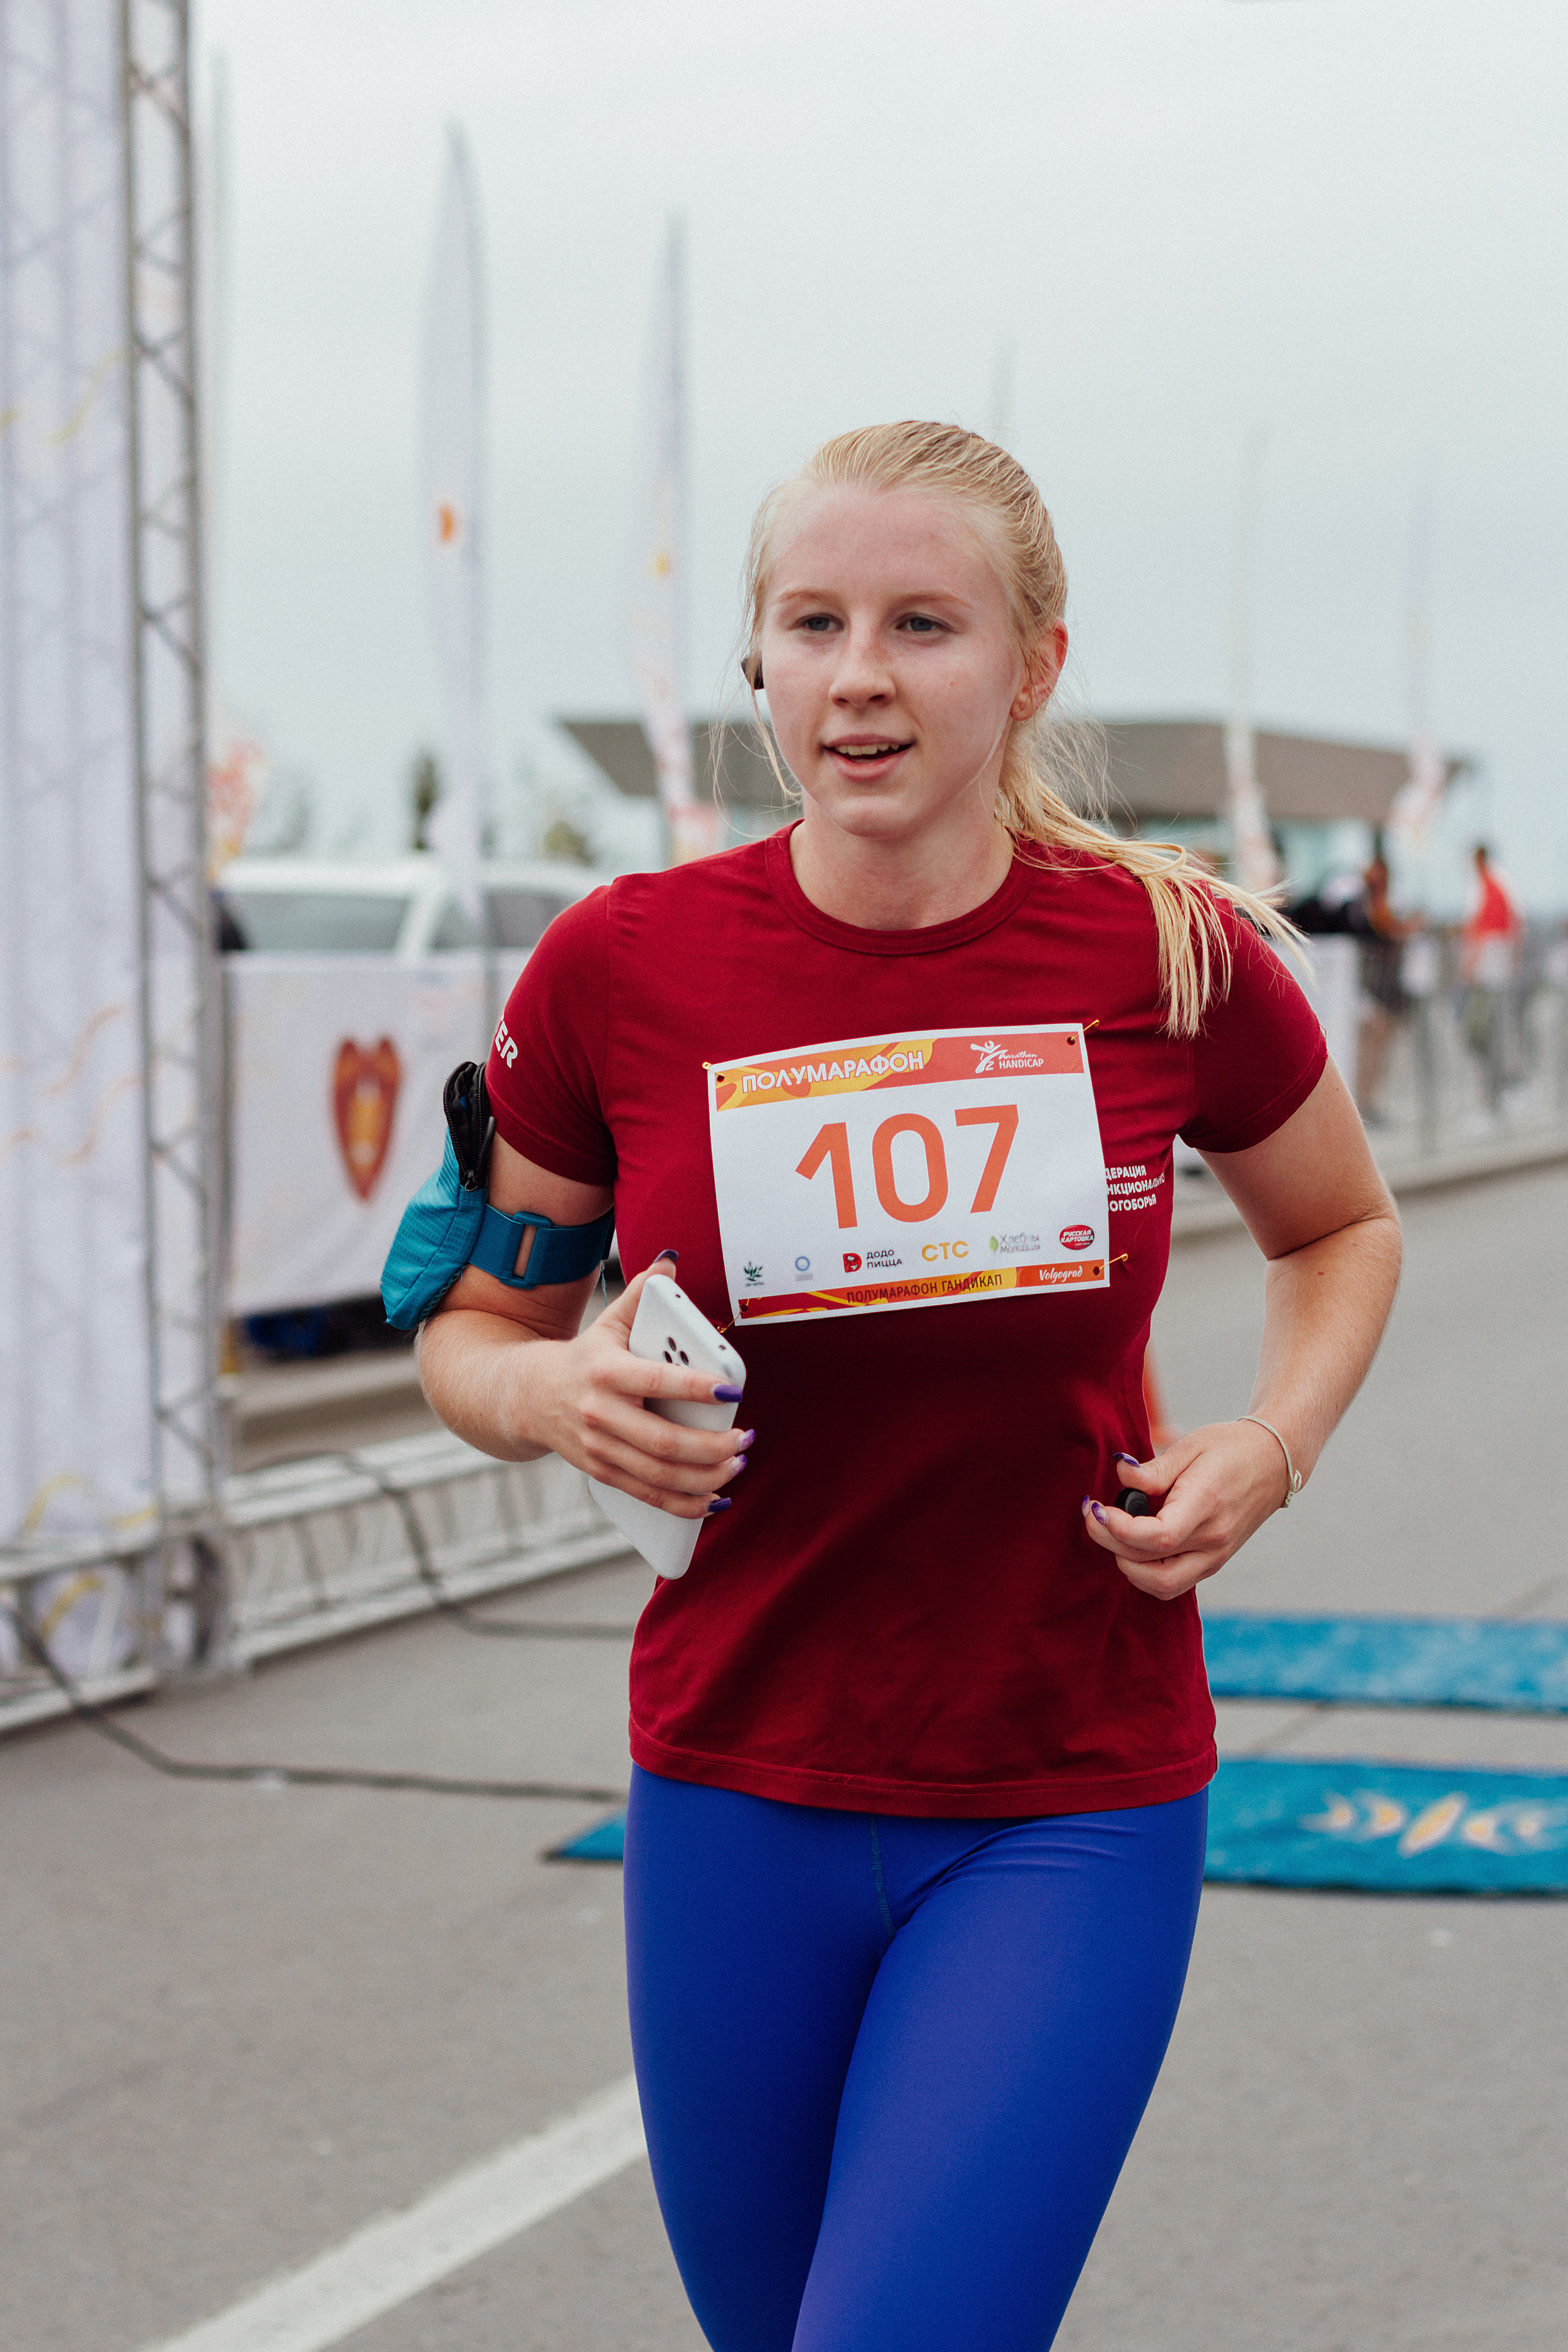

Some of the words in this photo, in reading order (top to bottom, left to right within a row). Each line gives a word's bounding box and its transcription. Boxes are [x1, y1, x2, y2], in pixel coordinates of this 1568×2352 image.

[495, 1016, 518, 1069] ER
[741, 1050, 924, 1093] ПОЛУМАРАФОН
[999, 1058, 1044, 1069] HANDICAP
[795, 1104, 1019, 1229] 107
[1104, 1165, 1147, 1181] ДЕРАЦИЯ
[1108, 1194, 1156, 1212] ОГОБОРЬЯ
[867, 1250, 894, 1259] ДОДО
[921, 1240, 970, 1262] СТС
[867, 1259, 903, 1268] ПИЦЦА
[1039, 1265, 1083, 1283] Volgograd
[846, 1279, 938, 1303] ПОЛУМАРАФОН
[941, 1274, 1003, 1292] ГАНДИКАП
